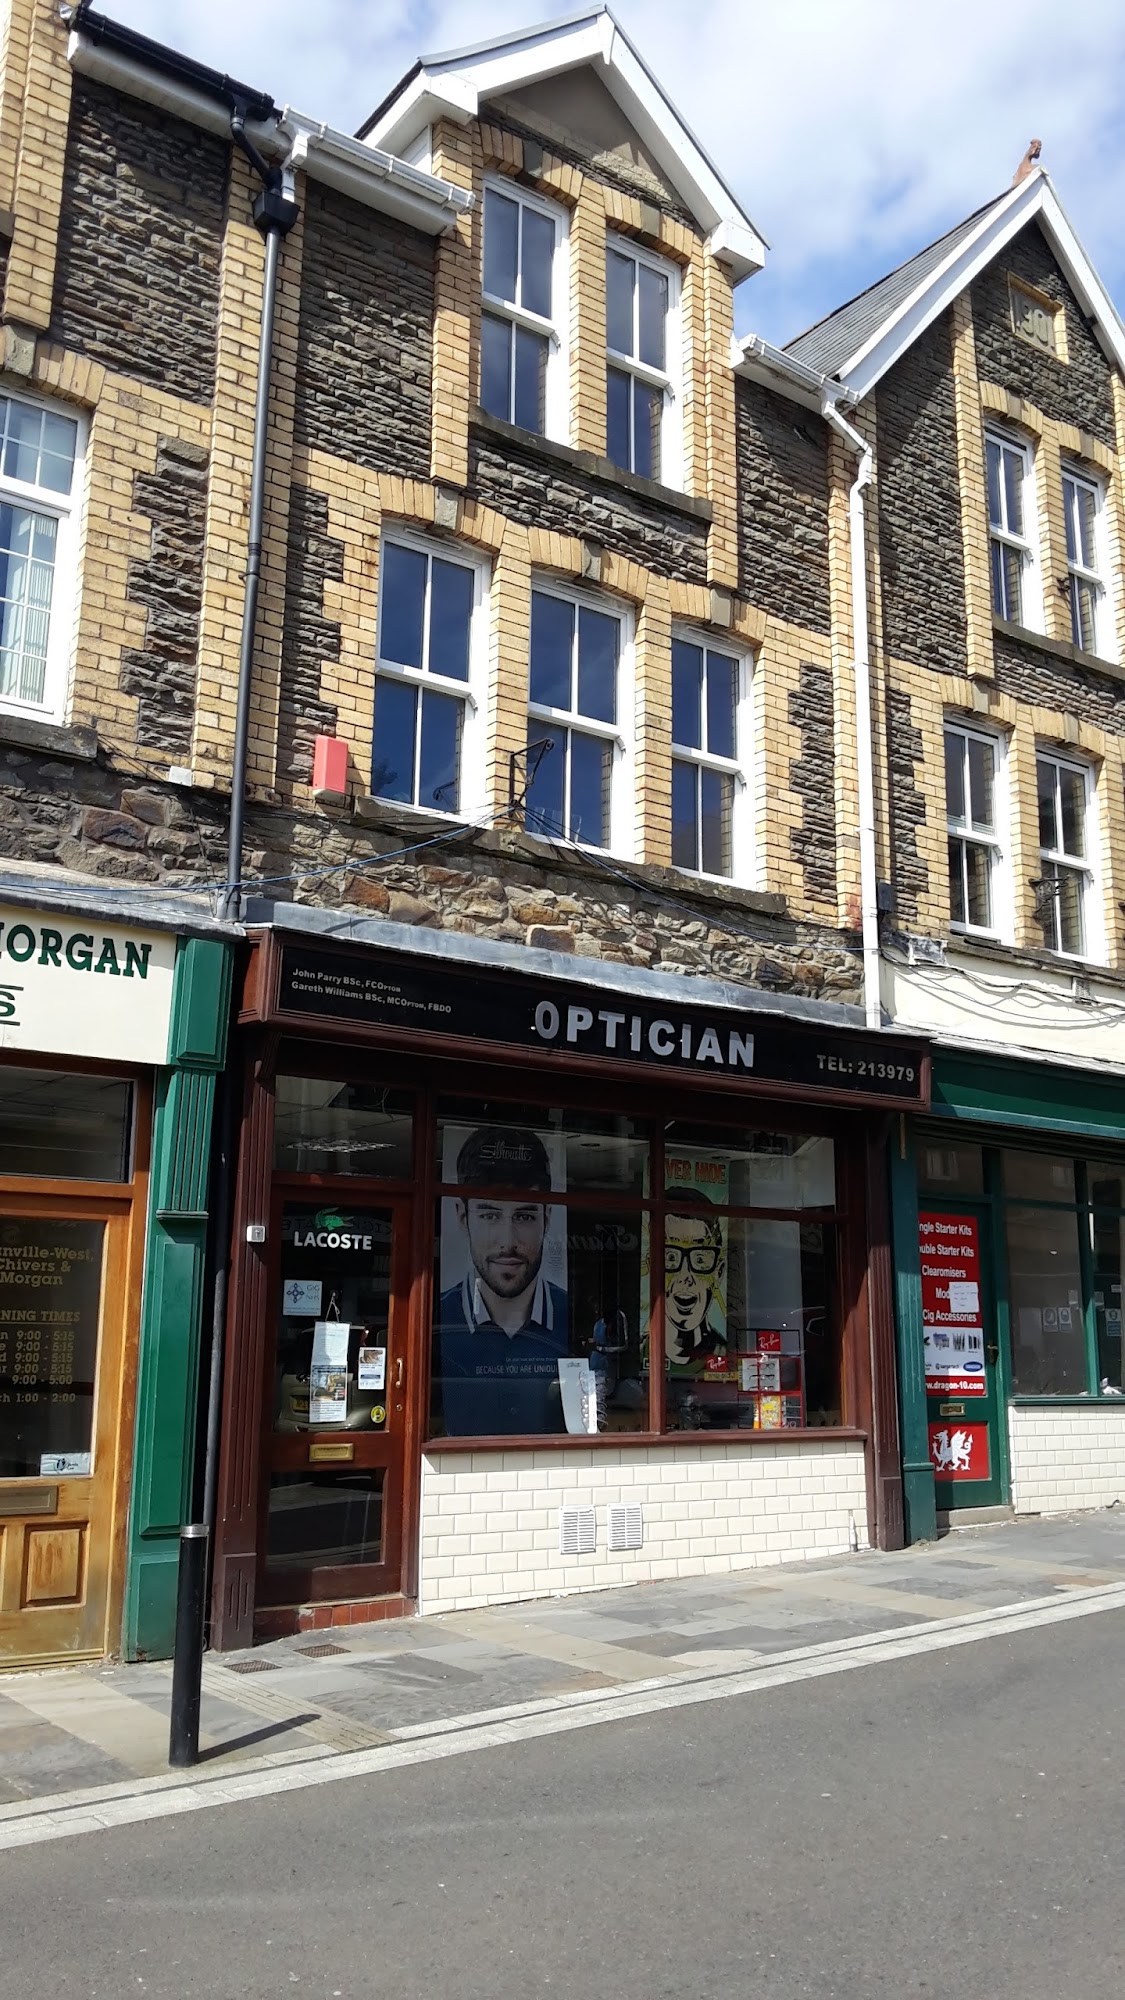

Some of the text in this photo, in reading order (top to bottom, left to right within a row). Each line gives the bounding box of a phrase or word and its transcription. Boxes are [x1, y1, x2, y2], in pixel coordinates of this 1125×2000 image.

[0, 922, 151, 979] ORGAN
[293, 968, 315, 980] John
[317, 972, 342, 985] Parry
[343, 976, 364, 989] BSc,
[291, 981, 323, 994] Gareth
[325, 986, 363, 1000] Williams
[365, 993, 386, 1005] BSc,
[534, 1000, 755, 1068] OPTICIAN
[816, 1054, 915, 1083] TEL: 213979
[665, 1158, 692, 1181] VER
[919, 1221, 972, 1236] ngle Starter Kits
[294, 1231, 373, 1251] LACOSTE
[0, 1245, 94, 1262] nville-West,
[920, 1243, 974, 1257] uble Starter Kits
[60, 1261, 71, 1272] &
[922, 1264, 966, 1278] Clearomisers
[0, 1272, 63, 1287] Morgan
[1, 1309, 80, 1322] NING TIMES
[935, 1310, 977, 1323] Accessories
[475, 1365, 504, 1375] BECAUSE
[505, 1365, 519, 1374] YOU
[519, 1364, 533, 1374] ARE
